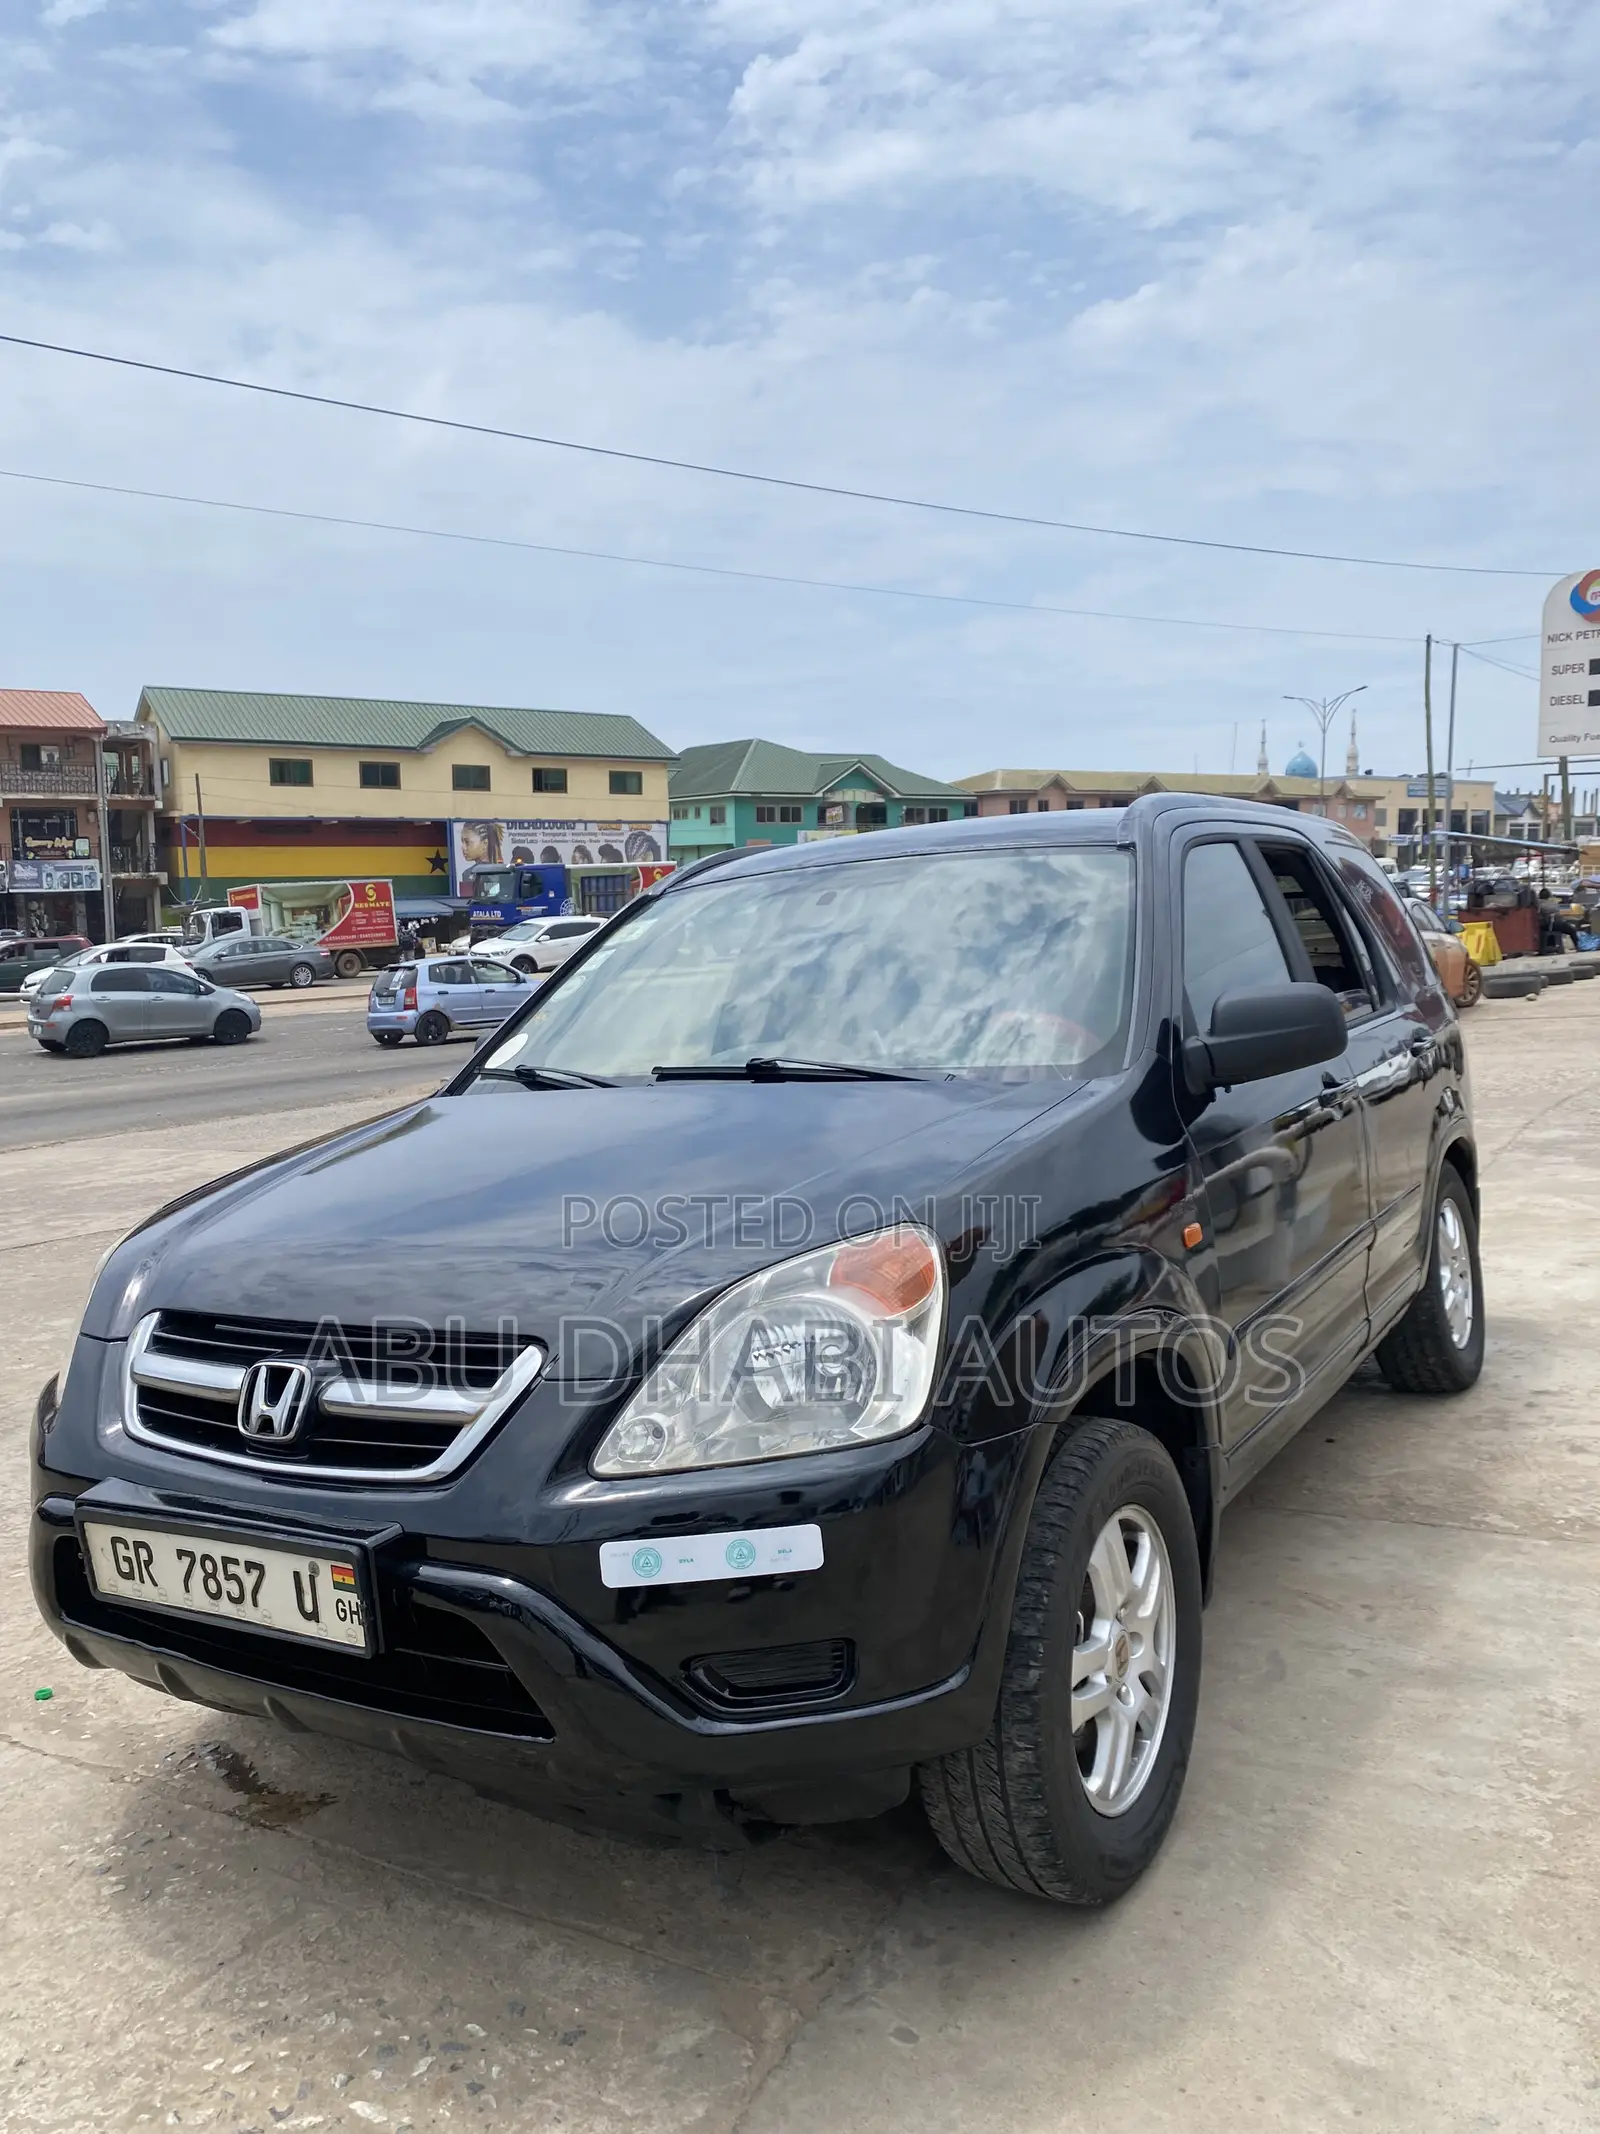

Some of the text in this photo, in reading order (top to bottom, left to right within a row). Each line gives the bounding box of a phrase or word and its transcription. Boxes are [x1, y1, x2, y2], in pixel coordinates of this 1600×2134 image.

[1547, 632, 1573, 644] NICK
[1551, 662, 1585, 675] SUPER
[1549, 694, 1585, 707] DIESEL
[1548, 733, 1581, 744] Quality
[490, 910, 502, 918] LTD
[110, 1535, 320, 1623] GR 7857 U
[335, 1597, 363, 1626] GH
